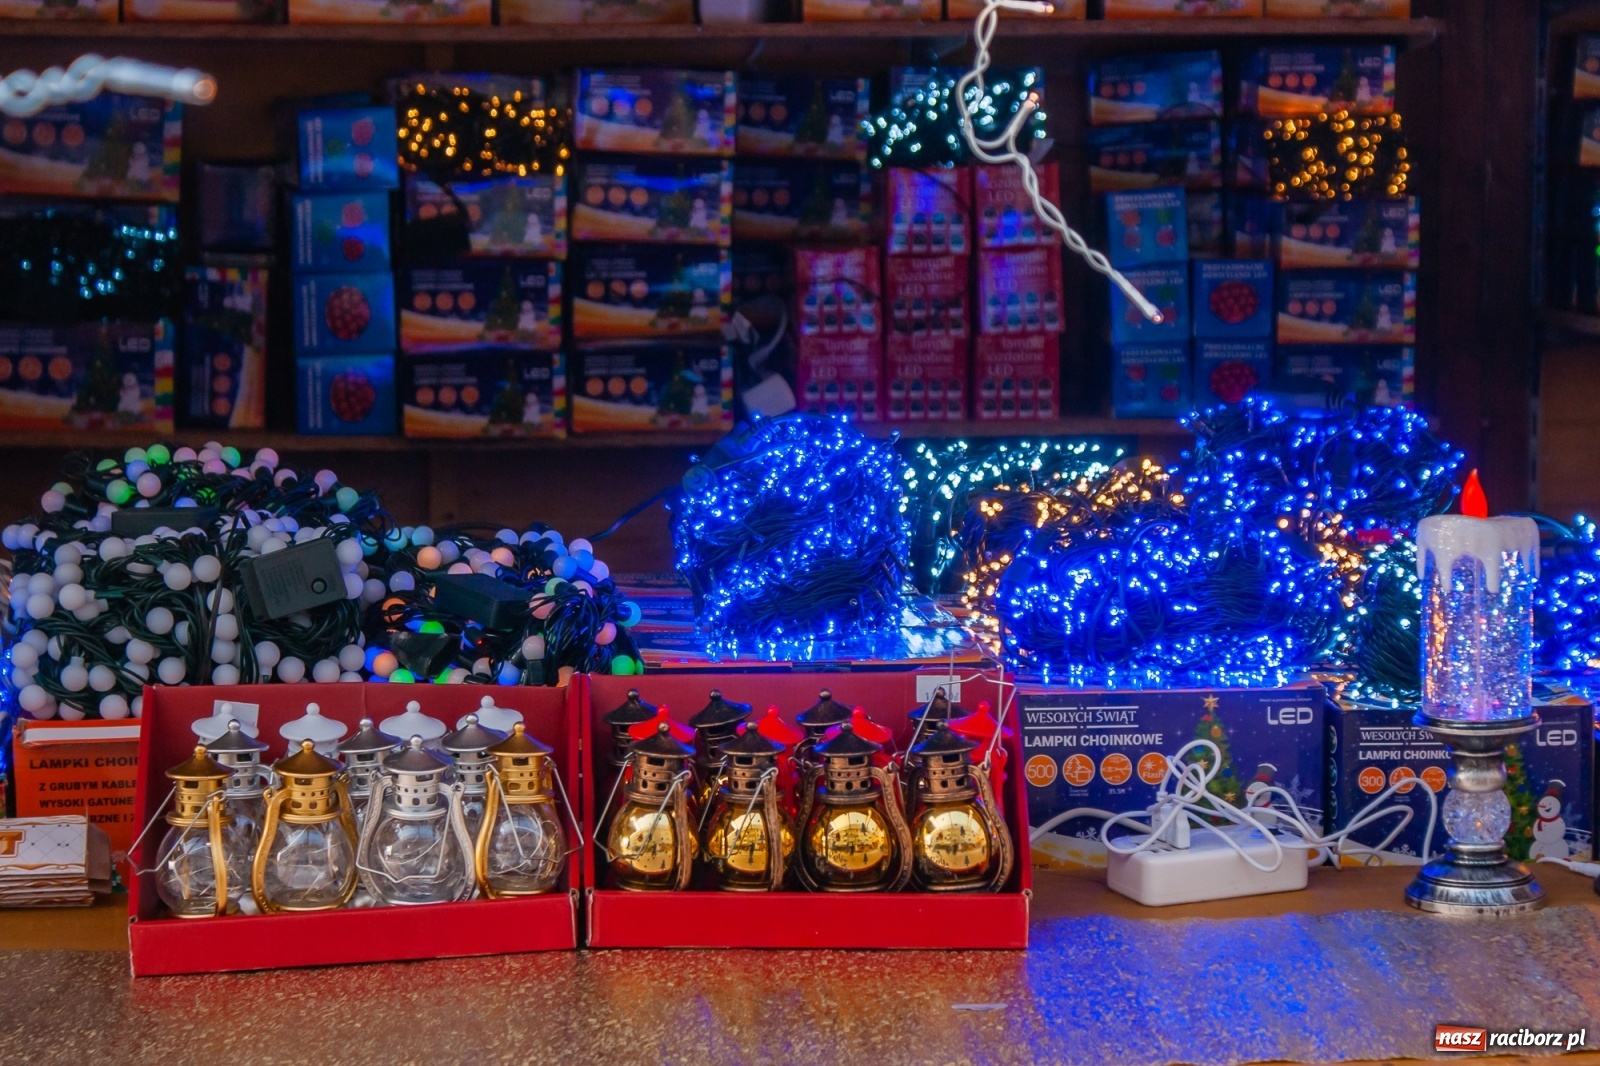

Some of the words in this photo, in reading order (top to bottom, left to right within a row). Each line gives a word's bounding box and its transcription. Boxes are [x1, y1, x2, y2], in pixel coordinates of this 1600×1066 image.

[1026, 711, 1092, 724] WESOŁYCH
[1096, 709, 1137, 725] ŚWIĄT
[1267, 706, 1313, 725] LED
[1024, 735, 1077, 747] LAMPKI
[1080, 733, 1163, 746] CHOINKOWE
[1361, 730, 1416, 741] WESOŁYCH
[1418, 729, 1434, 740] ŚW
[1536, 729, 1577, 746] LED
[1359, 750, 1401, 760] LAMPKI
[29, 758, 89, 770] LAMPKI
[1028, 764, 1055, 779] 500
[38, 782, 46, 791] Z
[49, 781, 98, 791] GRUBYM
[1361, 775, 1384, 787] 300
[39, 798, 84, 808] WYSOKI
[89, 814, 120, 824] RZNE
